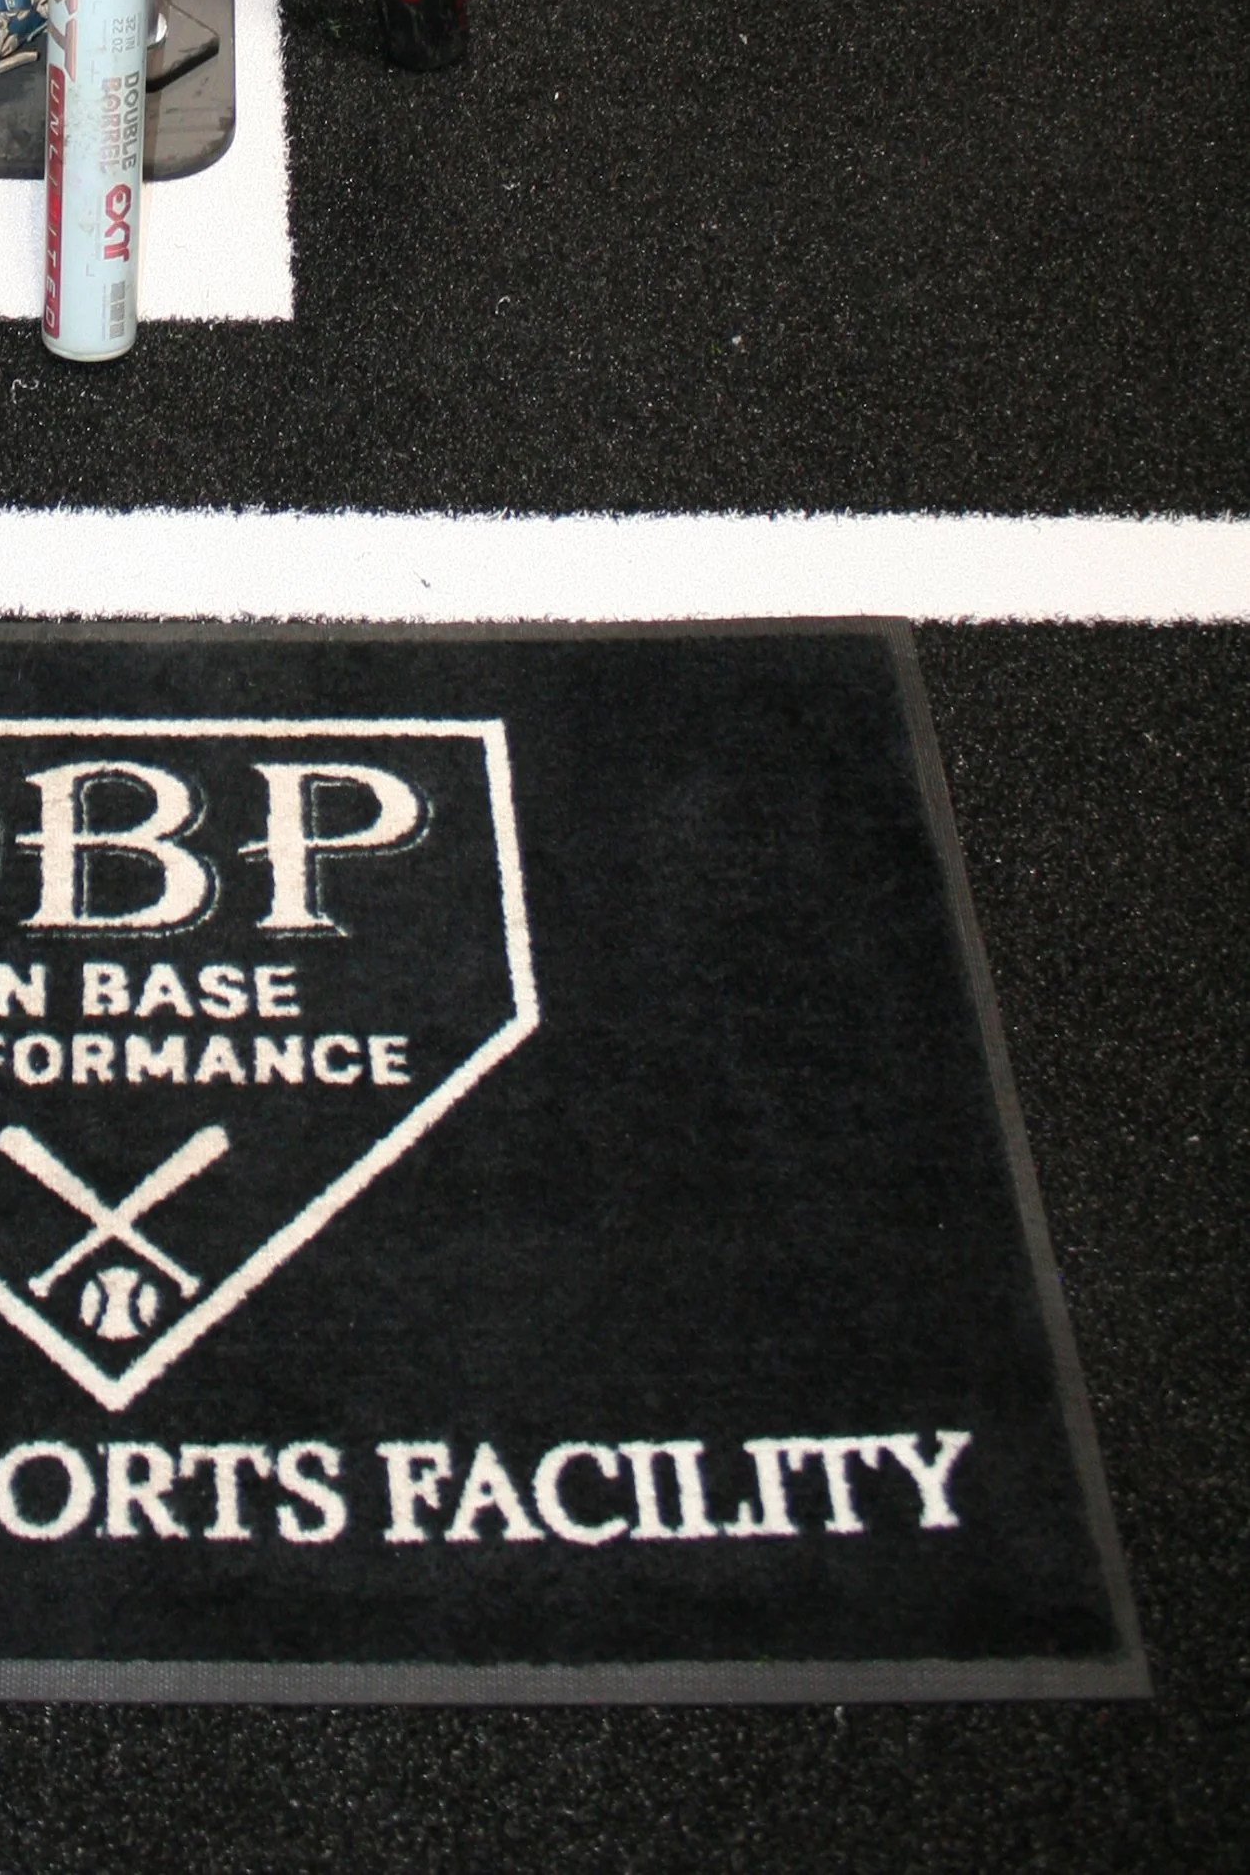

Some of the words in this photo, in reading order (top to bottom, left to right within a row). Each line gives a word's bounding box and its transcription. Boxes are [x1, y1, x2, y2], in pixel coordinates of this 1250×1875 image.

[112, 17, 124, 34] 22
[124, 14, 136, 34] 32
[124, 36, 136, 51] IN
[100, 77, 122, 174] BARREL
[122, 71, 140, 171] DOUBLE
[46, 77, 62, 329] UNLIITED
[81, 962, 301, 1019] BASE
[375, 1430, 972, 1545] FACILITY
